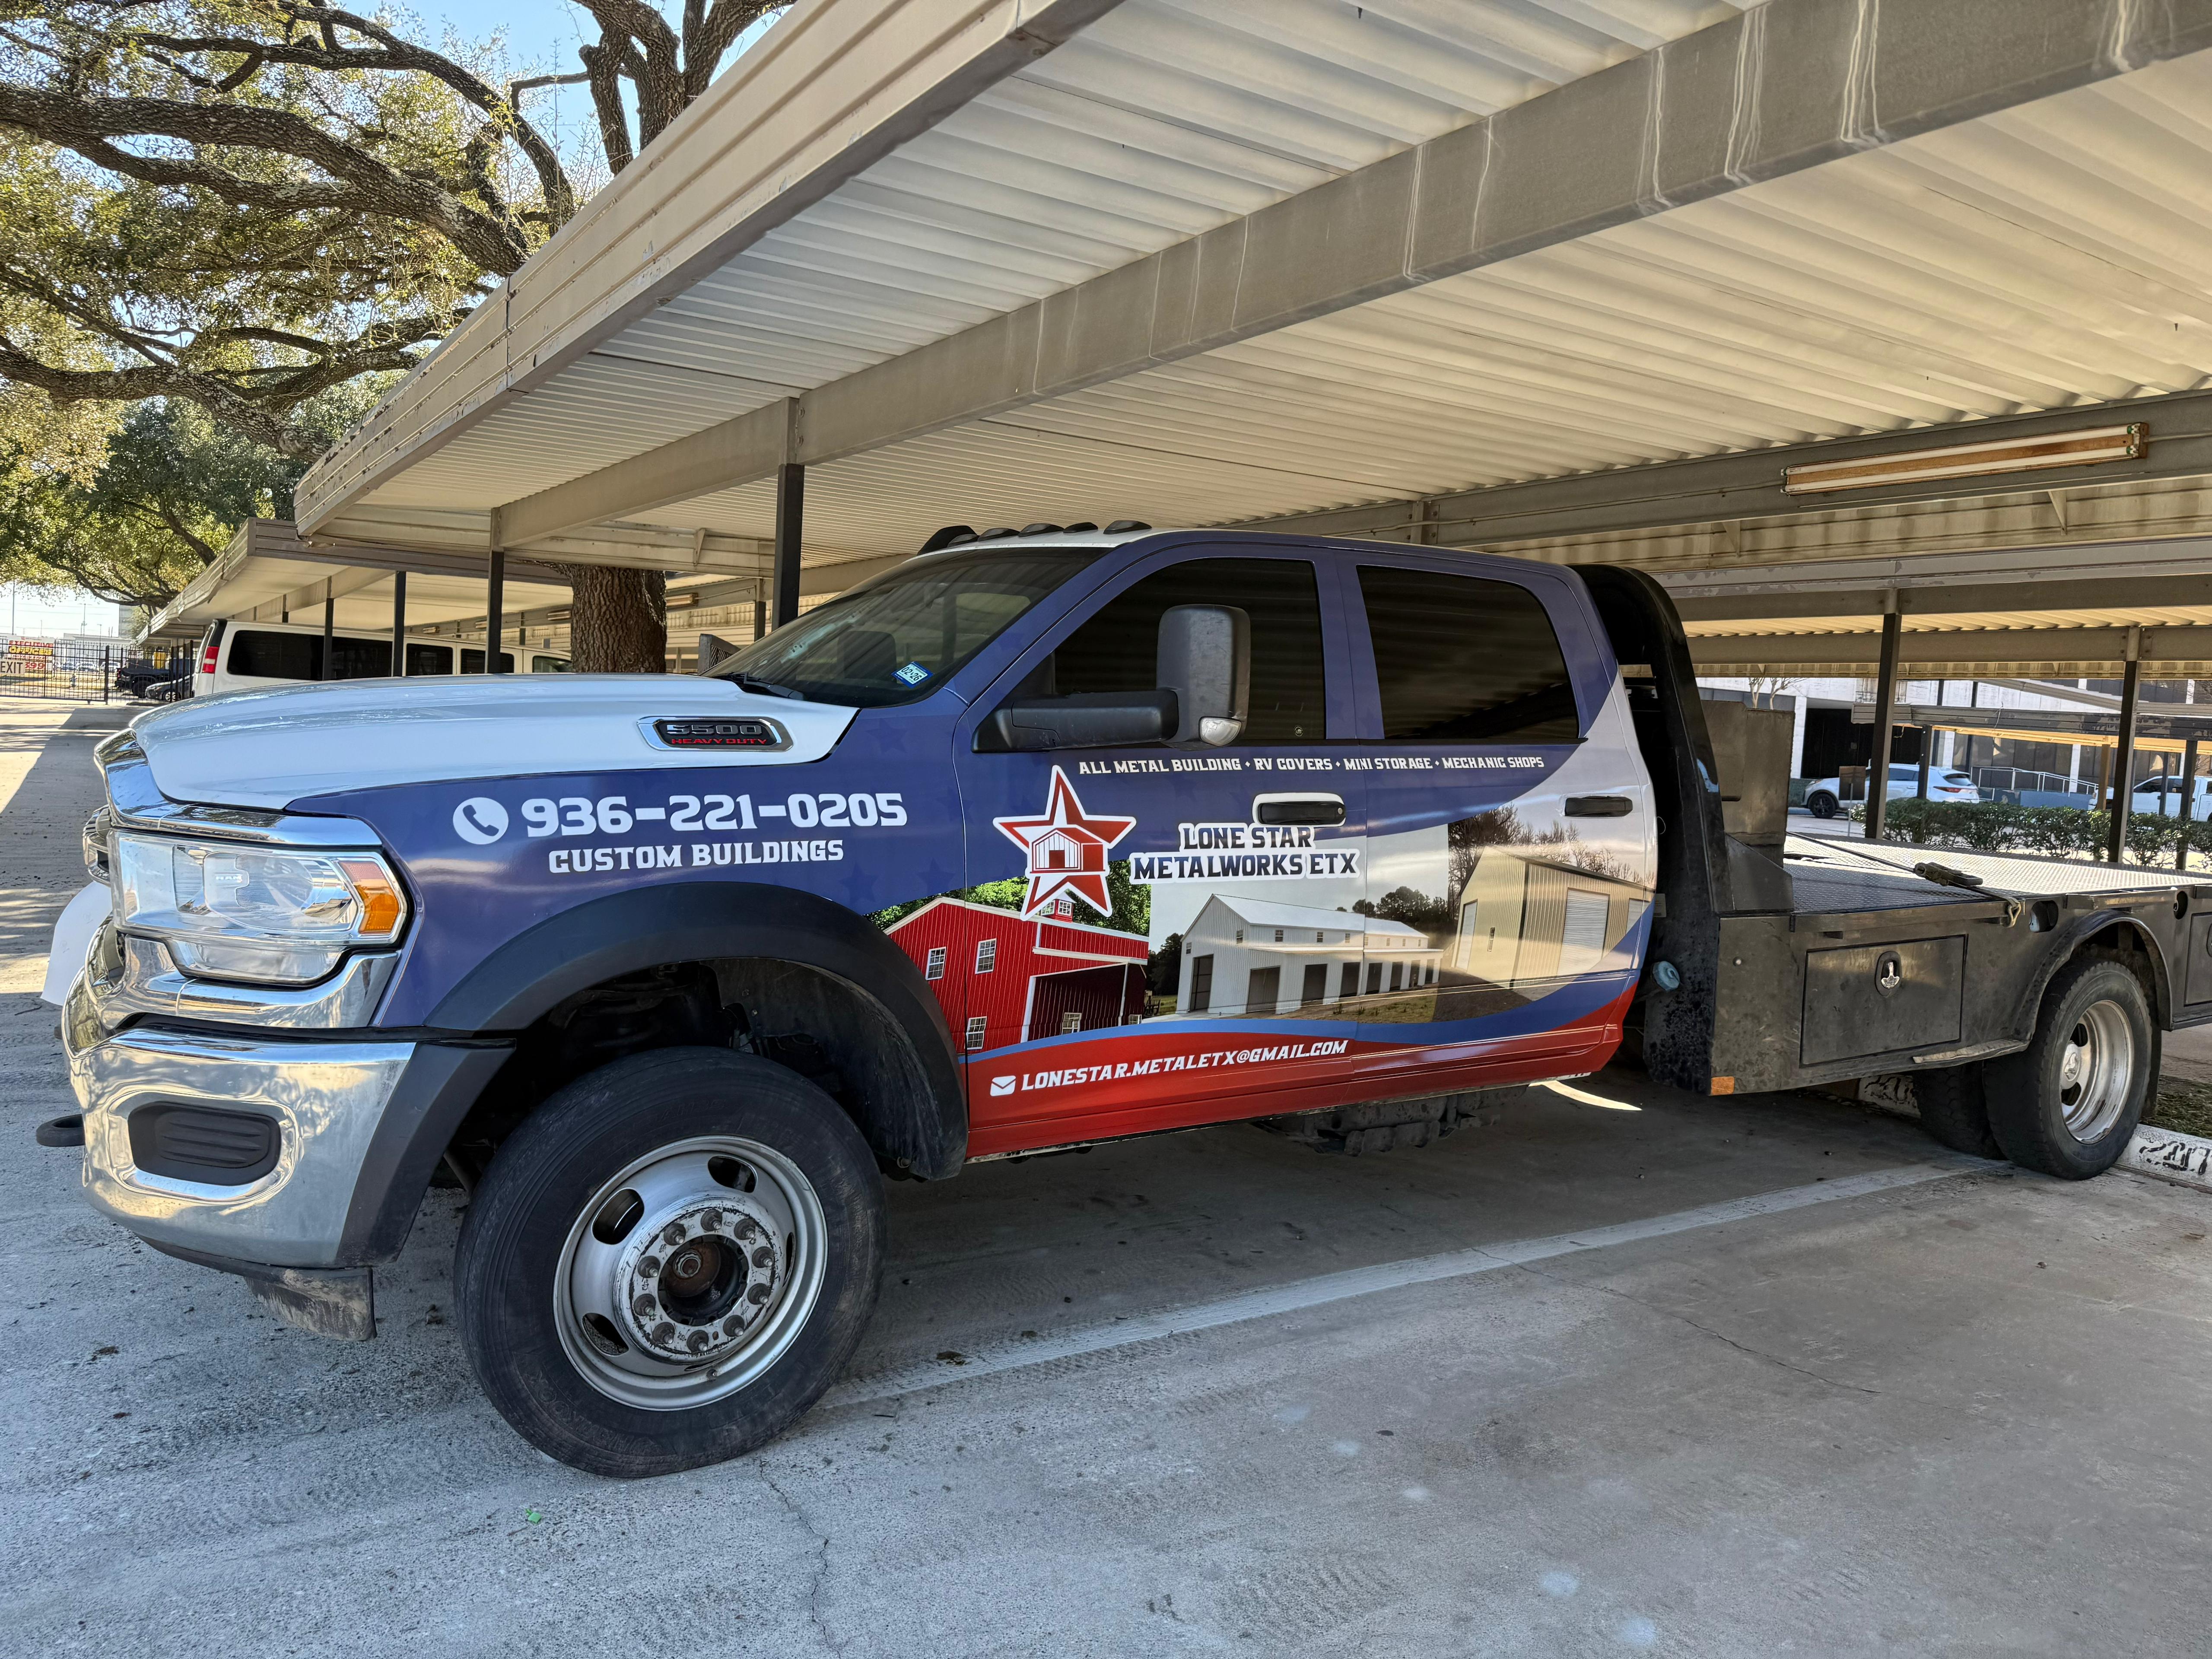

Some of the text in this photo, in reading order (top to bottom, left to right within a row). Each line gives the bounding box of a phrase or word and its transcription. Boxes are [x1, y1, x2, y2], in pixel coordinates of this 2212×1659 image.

[0, 661, 23, 674] EXIT
[667, 724, 762, 734] 5500
[1079, 756, 1545, 775] ALL METAL BUILDING RV COVERS MINI STORAGE MECHANIC SHOPS
[521, 793, 908, 837] 936-221-0205
[1182, 826, 1313, 850] LONE STAR
[548, 839, 844, 874] CUSTOM BUILDINGS
[1133, 853, 1357, 880] METALWORKS ETX
[1020, 1039, 1349, 1091] LONESTAR.METALETX@GMAIL.COM
